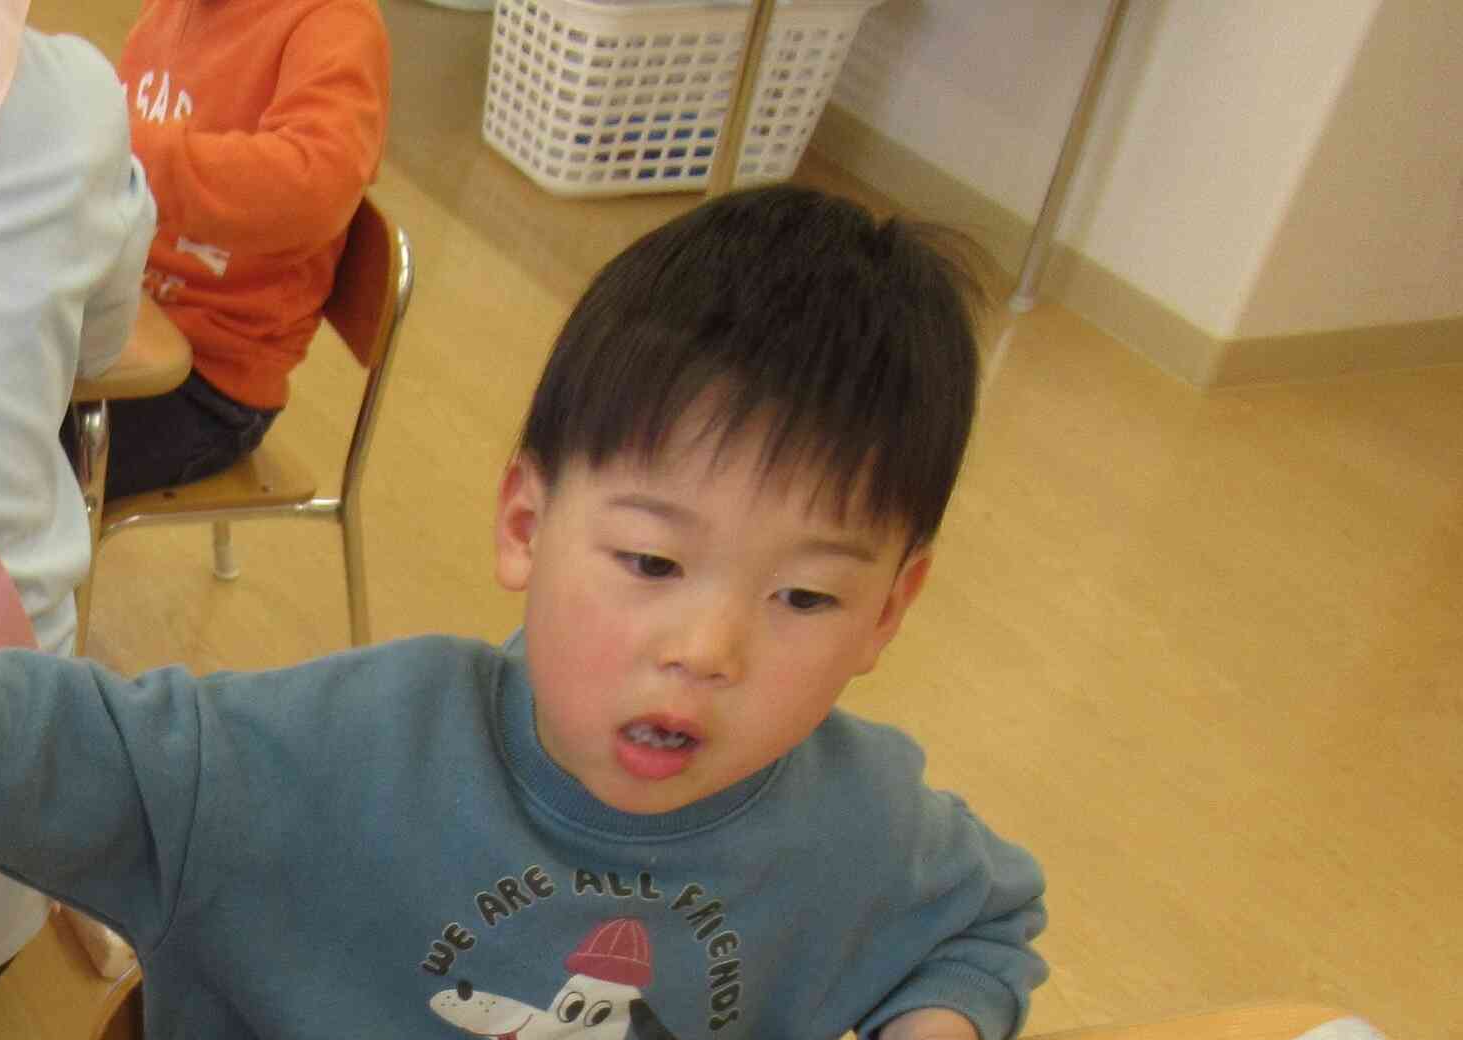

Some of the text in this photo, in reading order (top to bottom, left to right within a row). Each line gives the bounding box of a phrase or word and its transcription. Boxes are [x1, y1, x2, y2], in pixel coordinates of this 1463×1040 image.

[421, 922, 476, 977] WE
[474, 864, 554, 926] ARE
[574, 869, 661, 900] ALL
